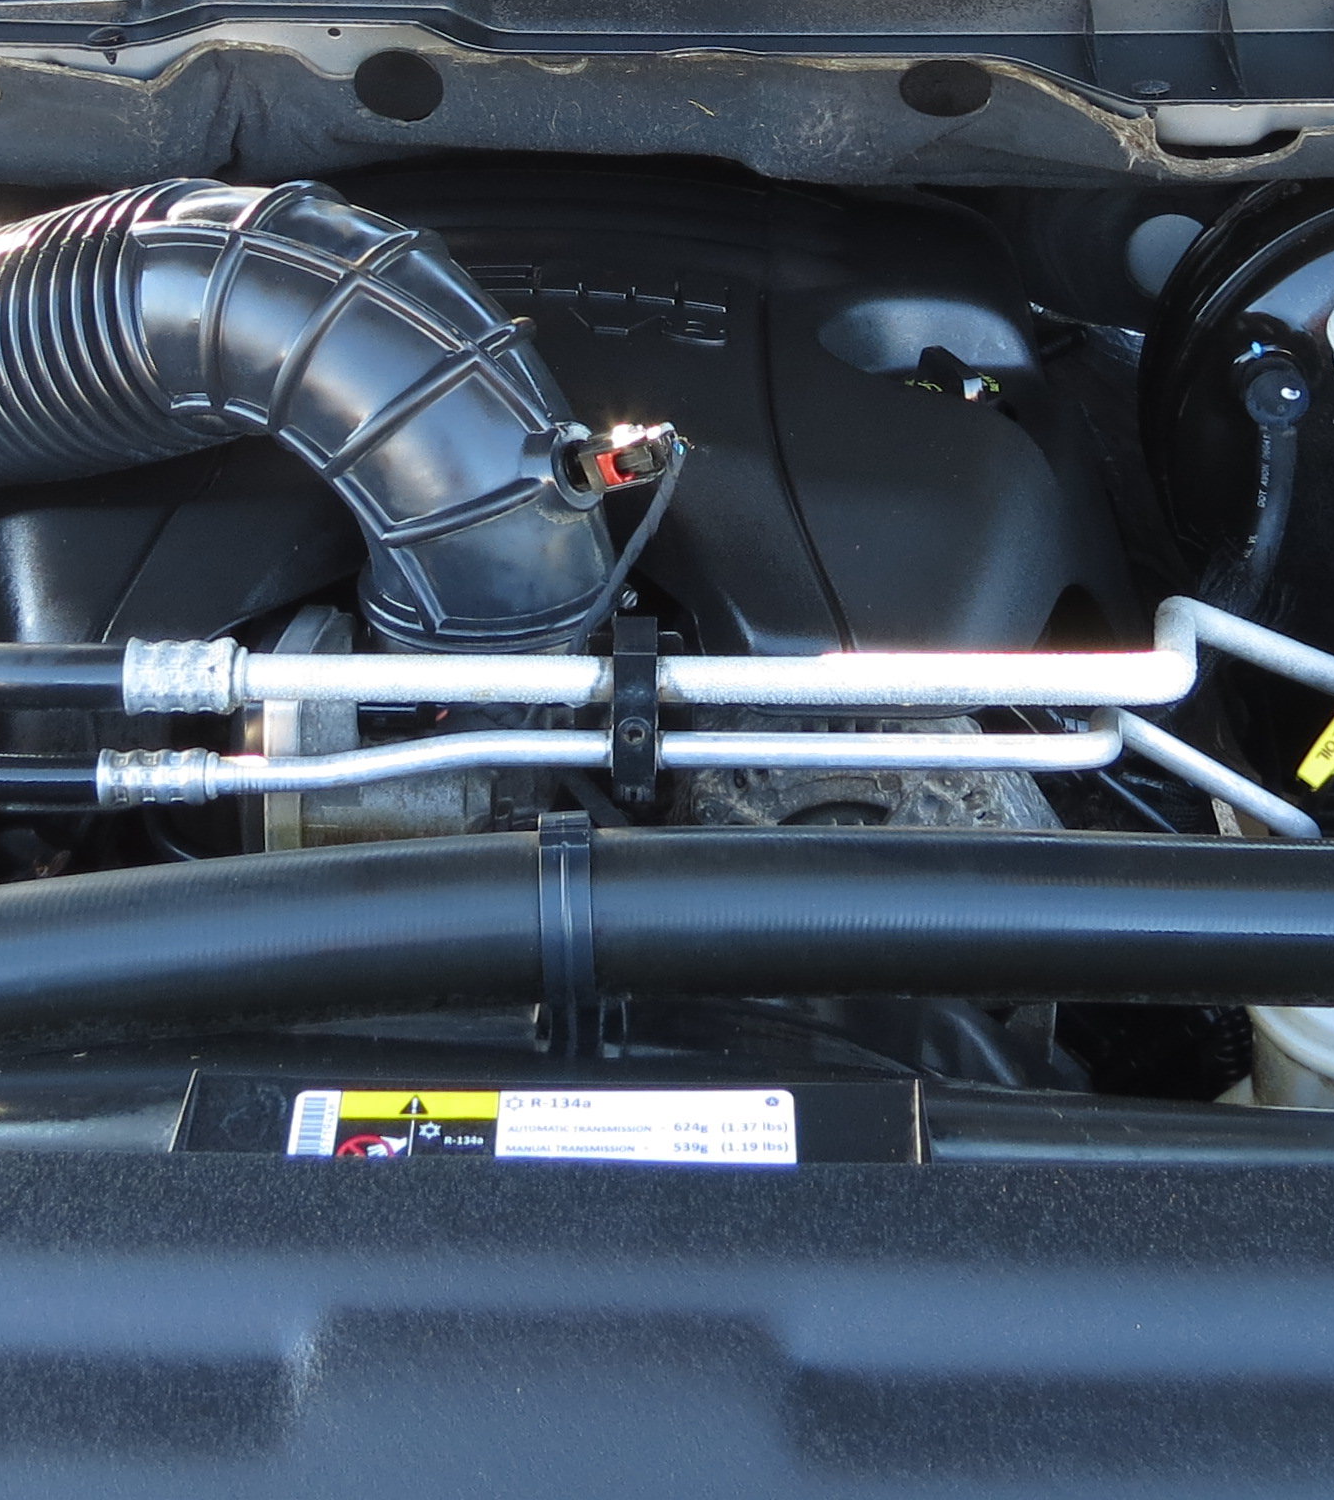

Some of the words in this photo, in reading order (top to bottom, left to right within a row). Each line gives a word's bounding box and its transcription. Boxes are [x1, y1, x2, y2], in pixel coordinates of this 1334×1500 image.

[530, 1098, 592, 1109] R-134a
[507, 1125, 569, 1133] AUTOMATIC
[574, 1125, 652, 1133] TRANSMISSION
[673, 1122, 708, 1133] 624g
[721, 1122, 758, 1133] (1.37
[762, 1121, 788, 1132] lbs)
[443, 1135, 484, 1145] R-134a
[556, 1145, 636, 1153] TRANSMISSION
[673, 1142, 708, 1154] 539g
[721, 1142, 758, 1153] (1.19
[762, 1142, 789, 1152] lbs)
